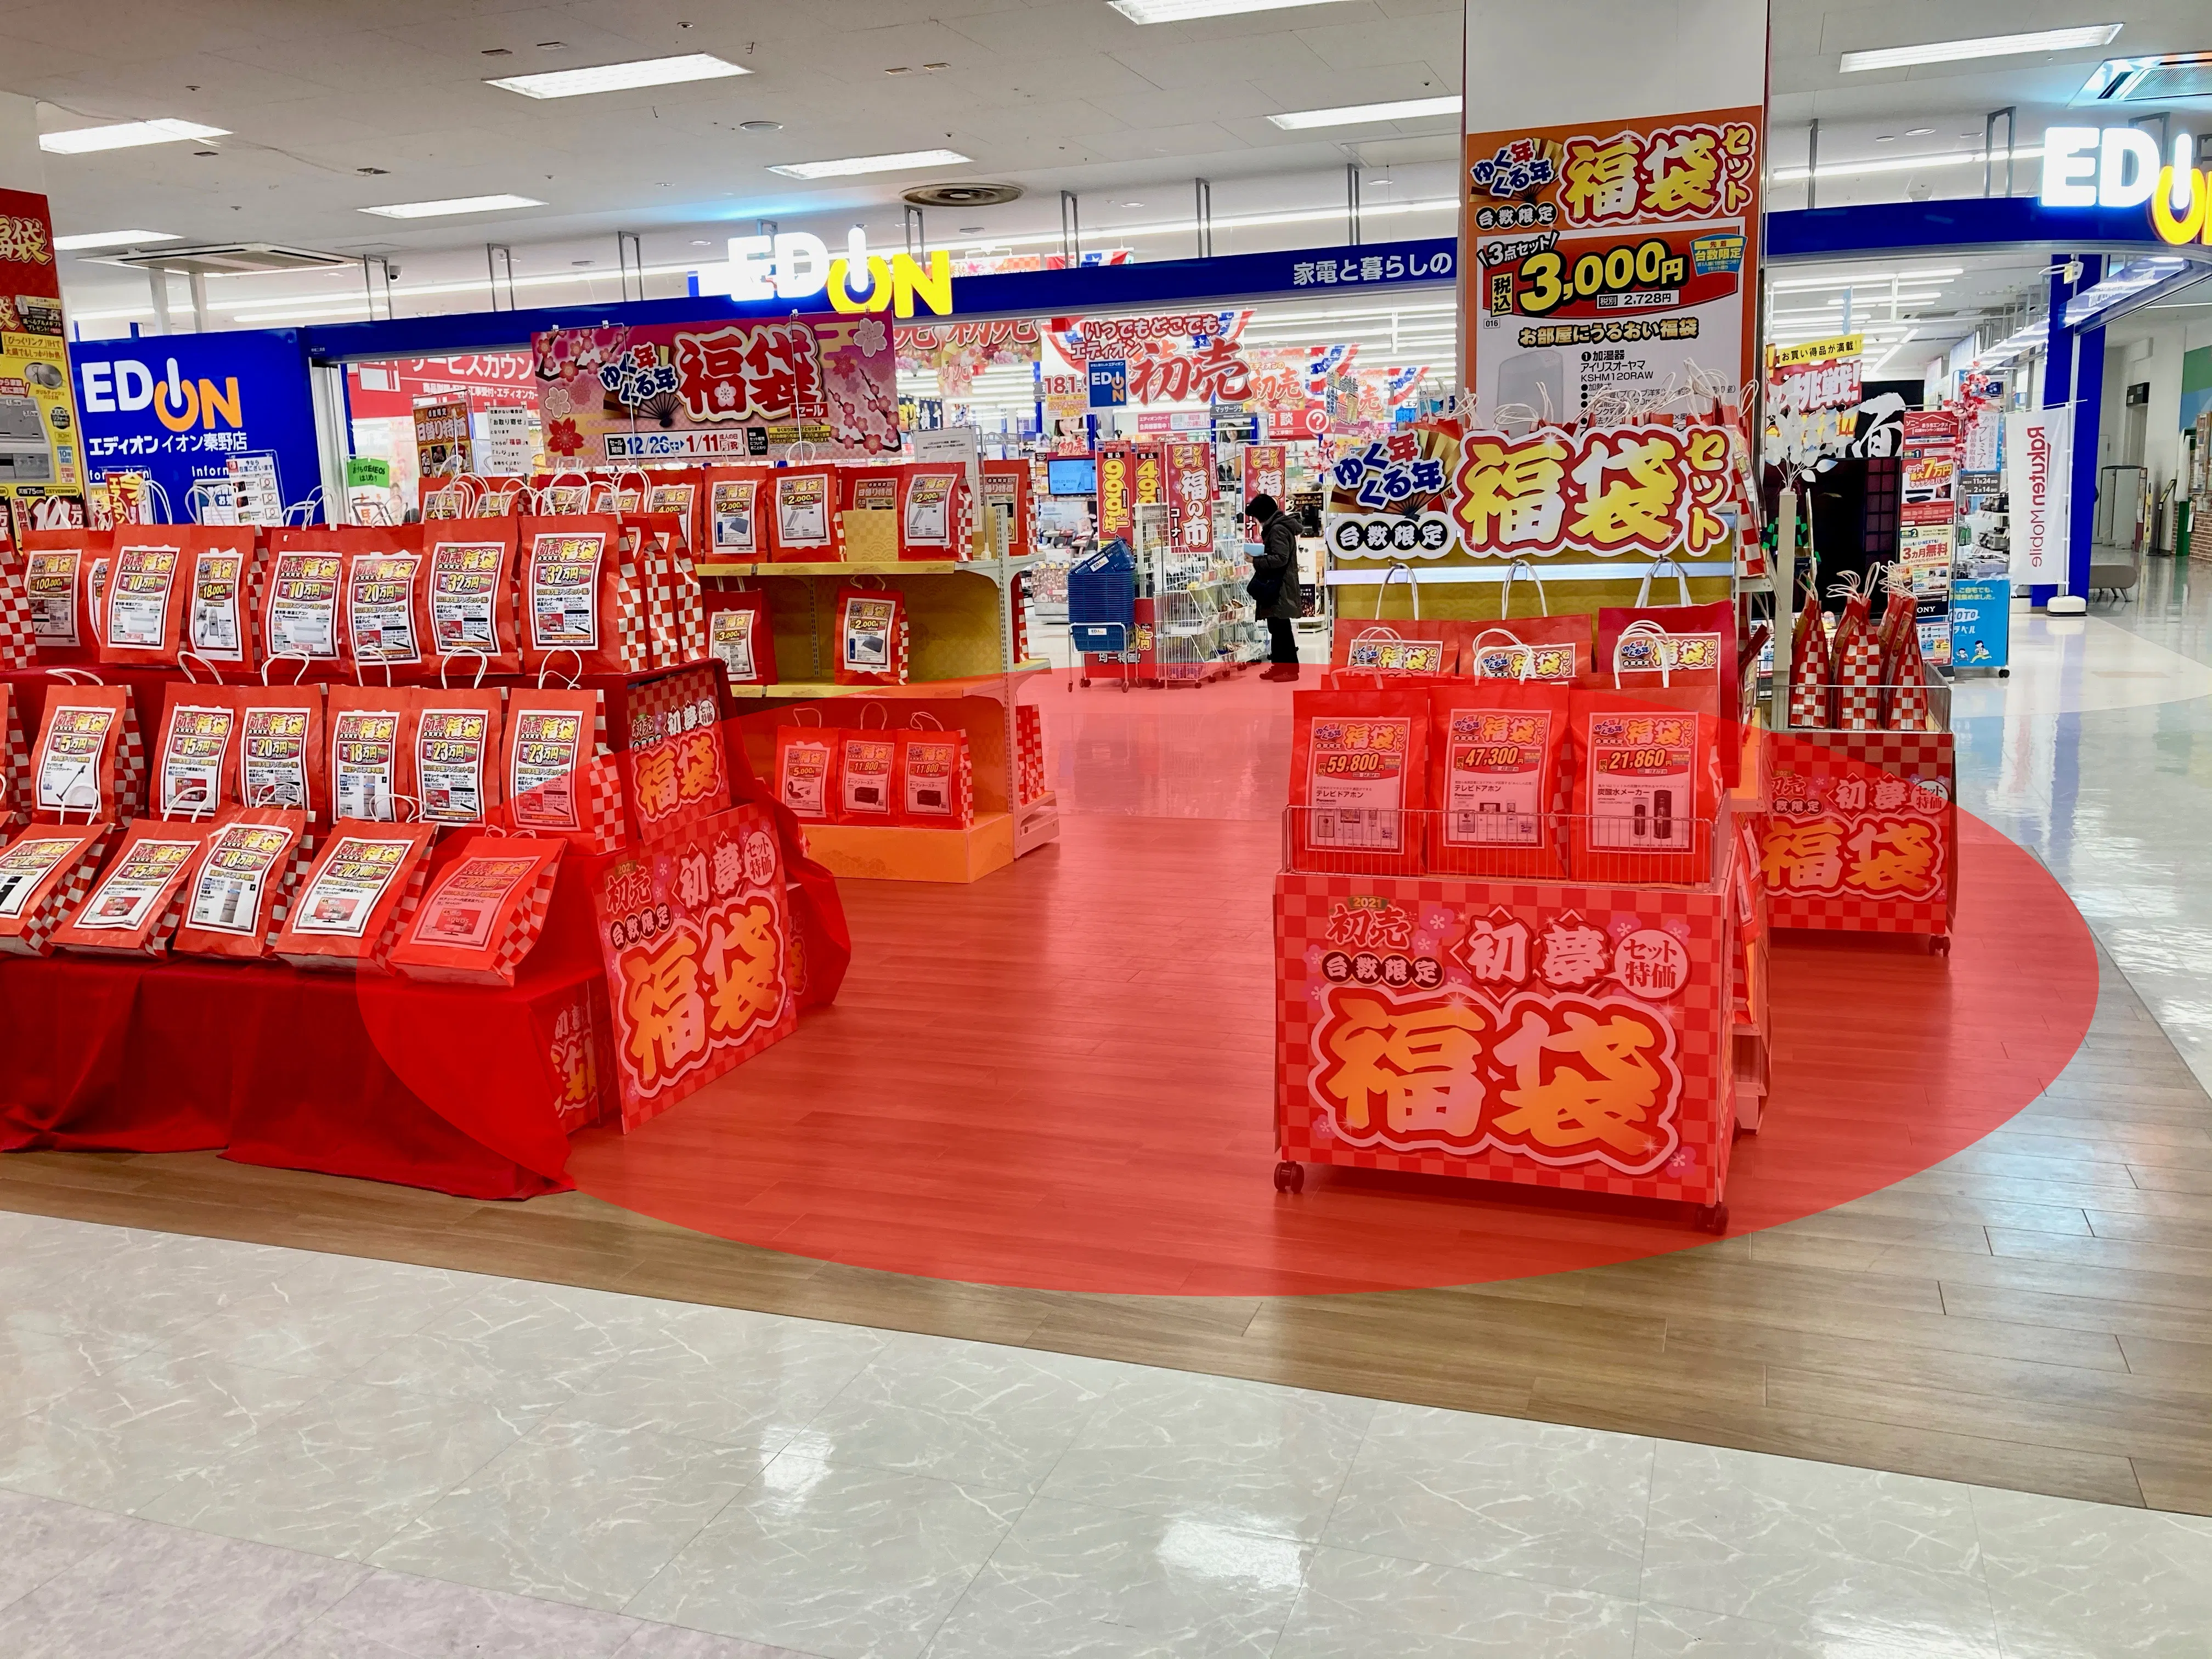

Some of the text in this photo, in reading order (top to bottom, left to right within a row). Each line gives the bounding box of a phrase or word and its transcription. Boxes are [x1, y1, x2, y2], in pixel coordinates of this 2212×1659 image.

[1474, 139, 1534, 185] ゆく年
[1722, 127, 1753, 211] セット
[1491, 161, 1555, 196] くる年
[1565, 133, 1718, 219] 福袋
[1479, 204, 1555, 227] 台数限定
[1487, 236, 1549, 264] 3点セット
[1695, 247, 1742, 262] 台数限定
[728, 227, 953, 318] EDION
[1293, 252, 1452, 285] 家電と暮らしの
[1521, 241, 1684, 314] 3,000円
[1493, 275, 1512, 314] 税込
[1600, 296, 1617, 306] 税別
[1624, 293, 1672, 306] 2,728円
[1085, 317, 1219, 339] いつでもどこでも
[1486, 319, 1499, 328] 016
[1519, 319, 1700, 347] お部屋にうるおい福袋
[1072, 340, 1142, 359] エディオン
[678, 330, 817, 414] 福袋
[1132, 337, 1251, 404] 初売
[1581, 360, 1646, 373] アイリスオーヤマ
[1581, 371, 1654, 382] KSHM120RAW
[81, 358, 242, 431] EDION
[1250, 369, 1304, 402] 初売
[795, 404, 825, 417] セール
[417, 416, 467, 441] 日替り特価
[610, 439, 624, 447] セール
[686, 434, 718, 453] 1/11
[1060, 437, 1088, 455] 初売
[1977, 426, 1989, 469] プレミアム
[1335, 433, 1418, 487] ゆく年
[1363, 460, 1445, 507] くる年
[1463, 438, 1677, 544] 福袋
[1688, 433, 1728, 549] セット
[1910, 476, 1950, 488] キャッシュバック
[721, 501, 743, 512] 2,000円
[788, 495, 814, 504] 2,000円
[916, 493, 938, 502] 2,000円
[1181, 470, 1210, 546] 福の市
[1171, 508, 1181, 548] コーナー
[1340, 524, 1443, 548] 台数限定
[463, 550, 499, 570] 福袋
[562, 540, 598, 561] 福袋
[1903, 543, 1948, 560] 3カ月無料
[303, 559, 337, 578] 福袋
[377, 562, 413, 580] 福袋
[547, 565, 579, 585] 32万円
[128, 575, 156, 590] 10万円
[290, 581, 323, 599] 10万円
[448, 573, 481, 594] 32万円
[364, 584, 396, 603] 20万円
[855, 619, 879, 629] 2,000円
[719, 630, 740, 641] 3,000円
[75, 715, 108, 732] 福袋
[197, 716, 229, 736] 福袋
[270, 716, 303, 736] 福袋
[360, 720, 392, 740] 福袋
[446, 718, 481, 739] 福袋
[541, 718, 578, 740] 福袋
[633, 716, 654, 737] 初売
[667, 704, 698, 736] 初夢
[1483, 716, 1534, 742] 福袋
[60, 736, 87, 751] 5万円
[1345, 725, 1394, 749] 福袋
[1628, 720, 1682, 746] 福袋
[183, 738, 210, 755] 15万円
[257, 739, 287, 758] 20万円
[348, 743, 377, 763] 18万円
[433, 742, 465, 761] 23万円
[529, 743, 560, 763] 23万円
[1465, 747, 1523, 766] 47,300円
[1327, 753, 1384, 772] 59,800円
[1609, 749, 1672, 769] 21,860円
[637, 736, 714, 815] 福袋
[793, 767, 815, 776] 5,000円
[1835, 779, 1906, 809] 初夢
[1916, 785, 1943, 795] セット
[1916, 795, 1942, 809] 特価
[747, 837, 770, 855] セット
[1760, 821, 1933, 891] 福袋
[221, 851, 257, 870] 18万円
[618, 863, 634, 873] 2021
[750, 853, 772, 878] 特価
[130, 865, 161, 878] 15万円
[680, 843, 742, 909] 初夢
[606, 866, 651, 913] 初売
[1353, 898, 1383, 908] 2021
[612, 906, 671, 946] 台数限定
[1329, 904, 1411, 949] 初売
[1466, 919, 1606, 986] 初夢
[1624, 939, 1677, 964] セット
[1327, 956, 1438, 983] 台数限定
[1624, 962, 1676, 990] 特価
[625, 905, 776, 1080] 福袋
[1325, 997, 1660, 1156] 福袋
